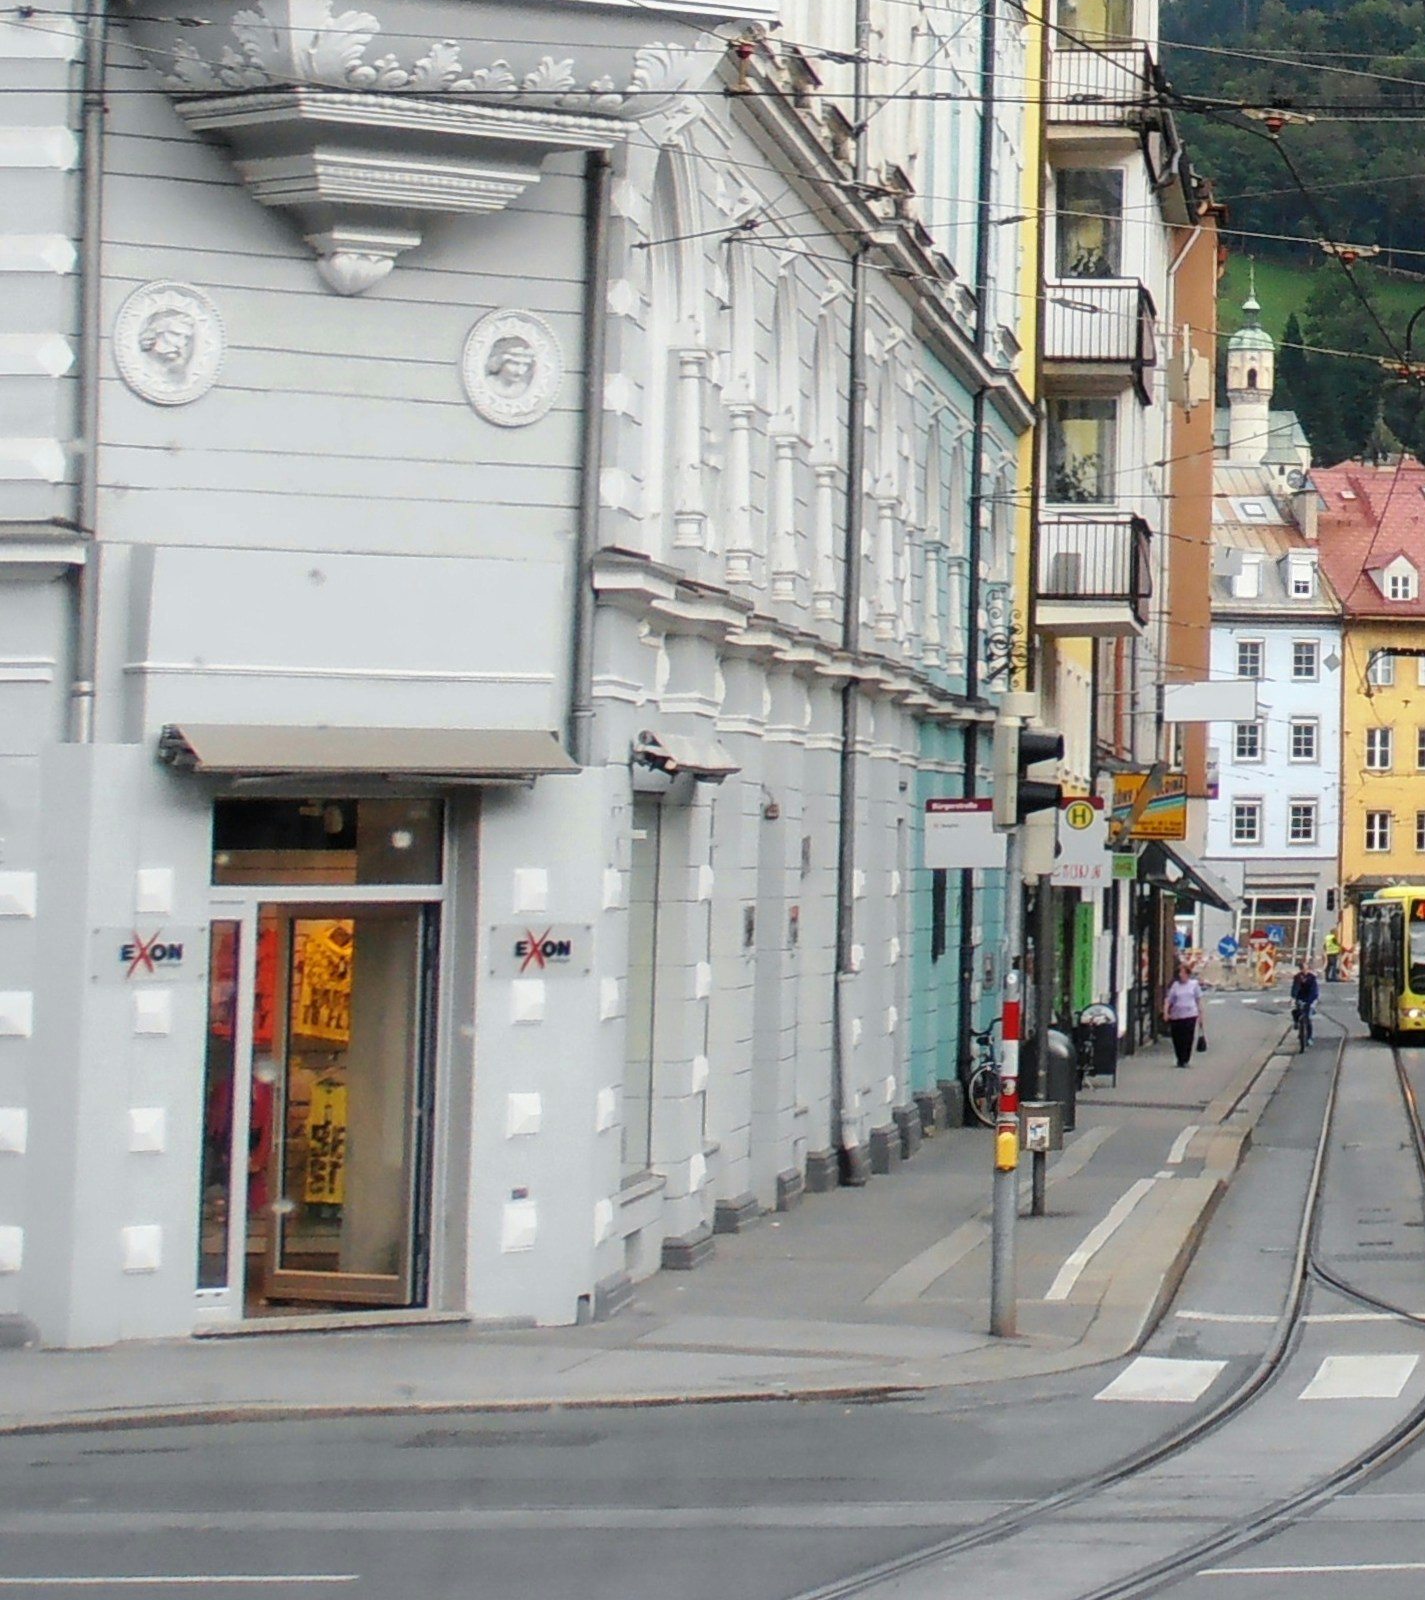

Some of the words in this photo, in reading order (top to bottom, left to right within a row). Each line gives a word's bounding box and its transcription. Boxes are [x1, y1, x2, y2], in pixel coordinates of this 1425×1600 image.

[1072, 807, 1087, 825] H
[119, 928, 183, 979] EXON
[514, 925, 571, 973] EXON
